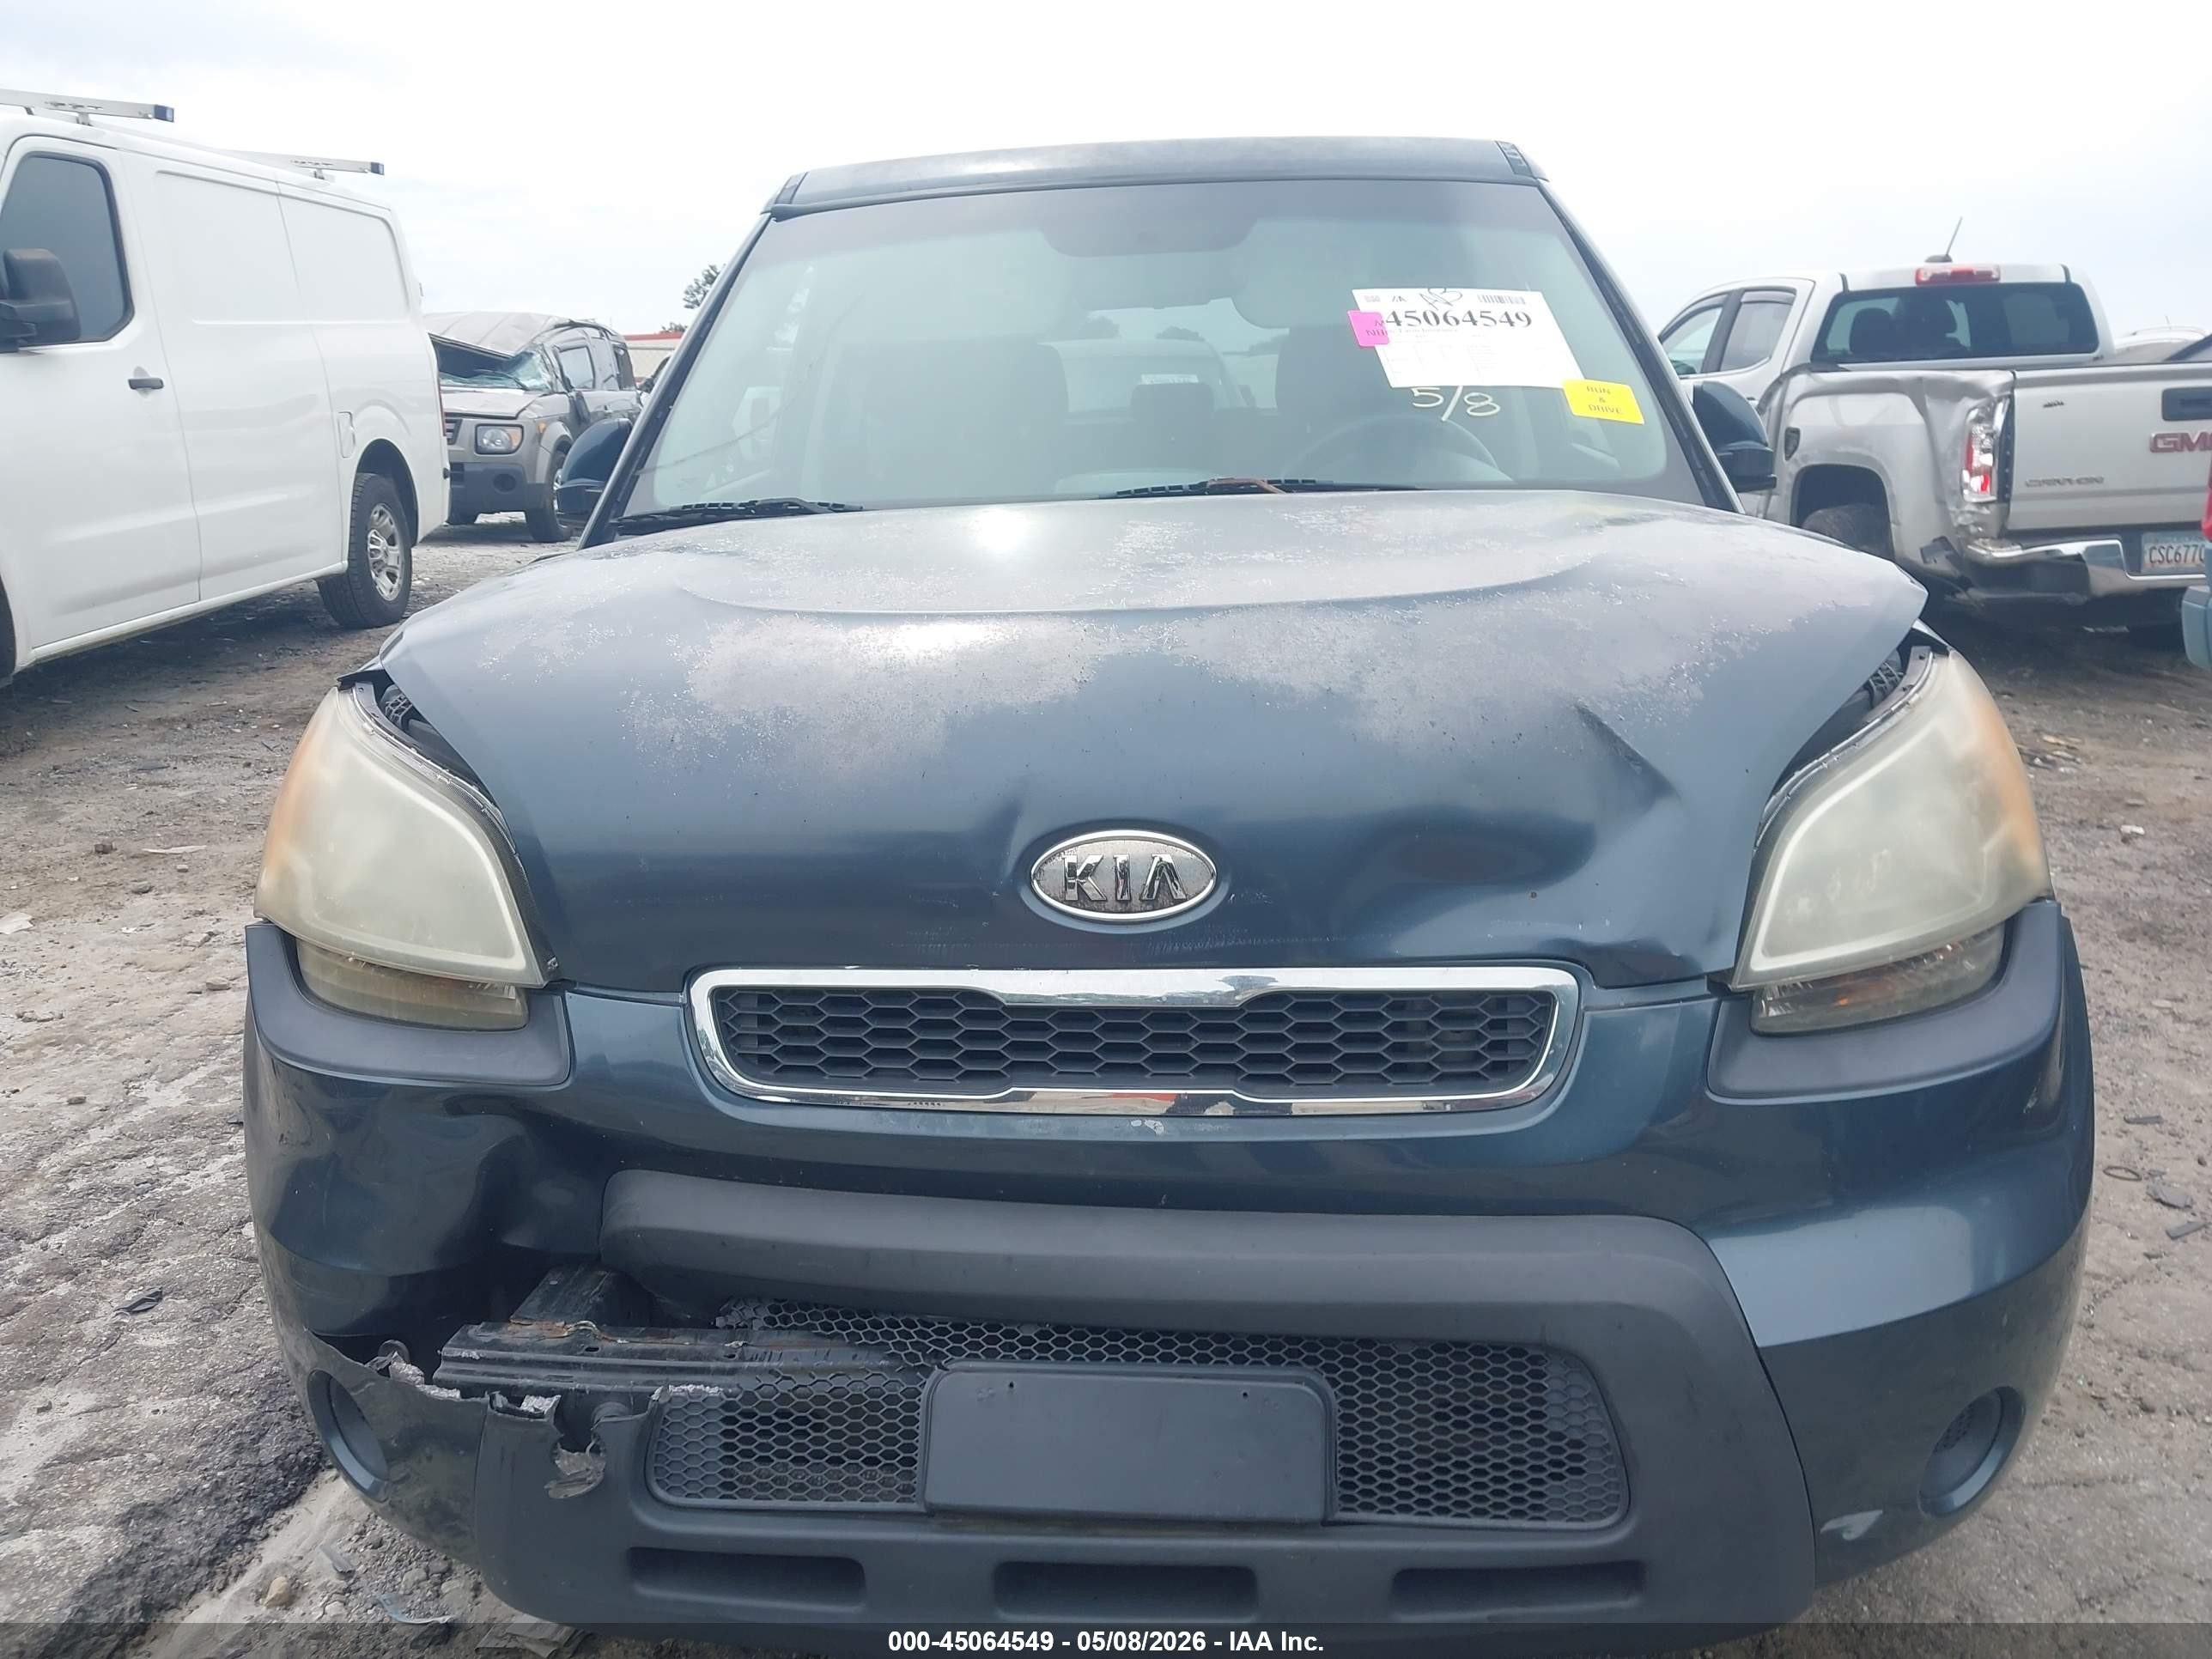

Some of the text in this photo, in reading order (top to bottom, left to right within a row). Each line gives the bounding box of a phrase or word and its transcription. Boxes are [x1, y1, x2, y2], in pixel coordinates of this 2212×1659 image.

[1386, 309, 1532, 327] 45064549
[1586, 385, 1611, 394] RUN
[1410, 386, 1501, 422] 5/8
[1588, 404, 1622, 414] DRIVE
[2150, 431, 2212, 453] GM
[2025, 476, 2105, 488] CANYON
[1060, 852, 1188, 902] KIA
